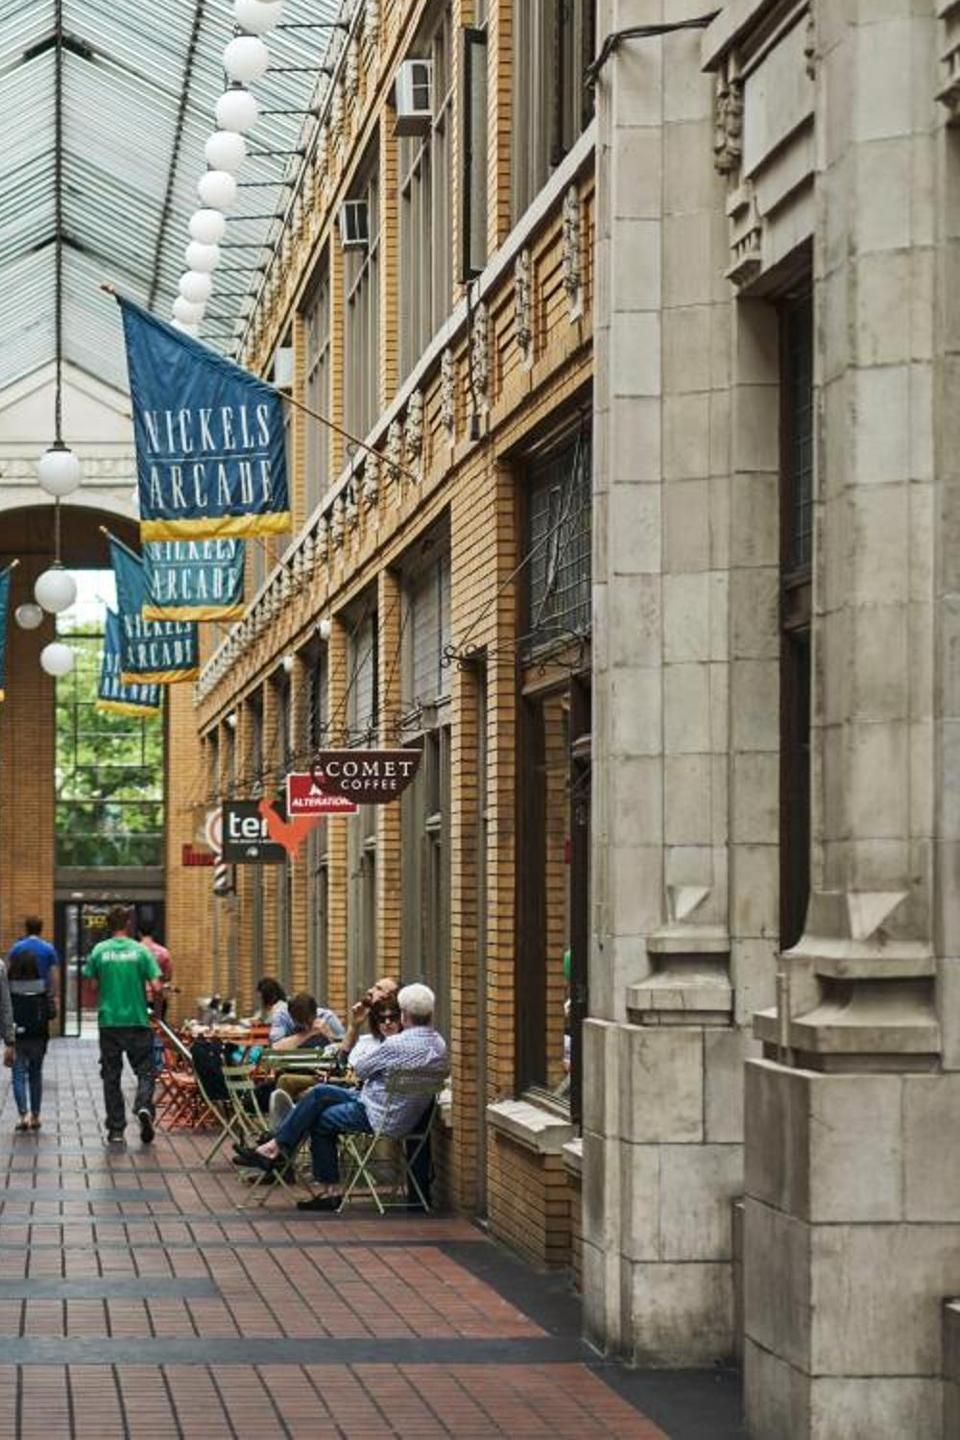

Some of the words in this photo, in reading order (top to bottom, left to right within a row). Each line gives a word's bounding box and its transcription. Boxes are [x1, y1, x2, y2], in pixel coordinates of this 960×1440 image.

[144, 405, 270, 454] NICKELS
[150, 460, 273, 509] ARCADE
[151, 539, 236, 560] NICKELS
[151, 568, 238, 600] ARCADE
[127, 639, 193, 667] ARCADE
[325, 761, 413, 777] COMET
[341, 779, 397, 790] COFFEE
[291, 796, 354, 808] ALTERATION
